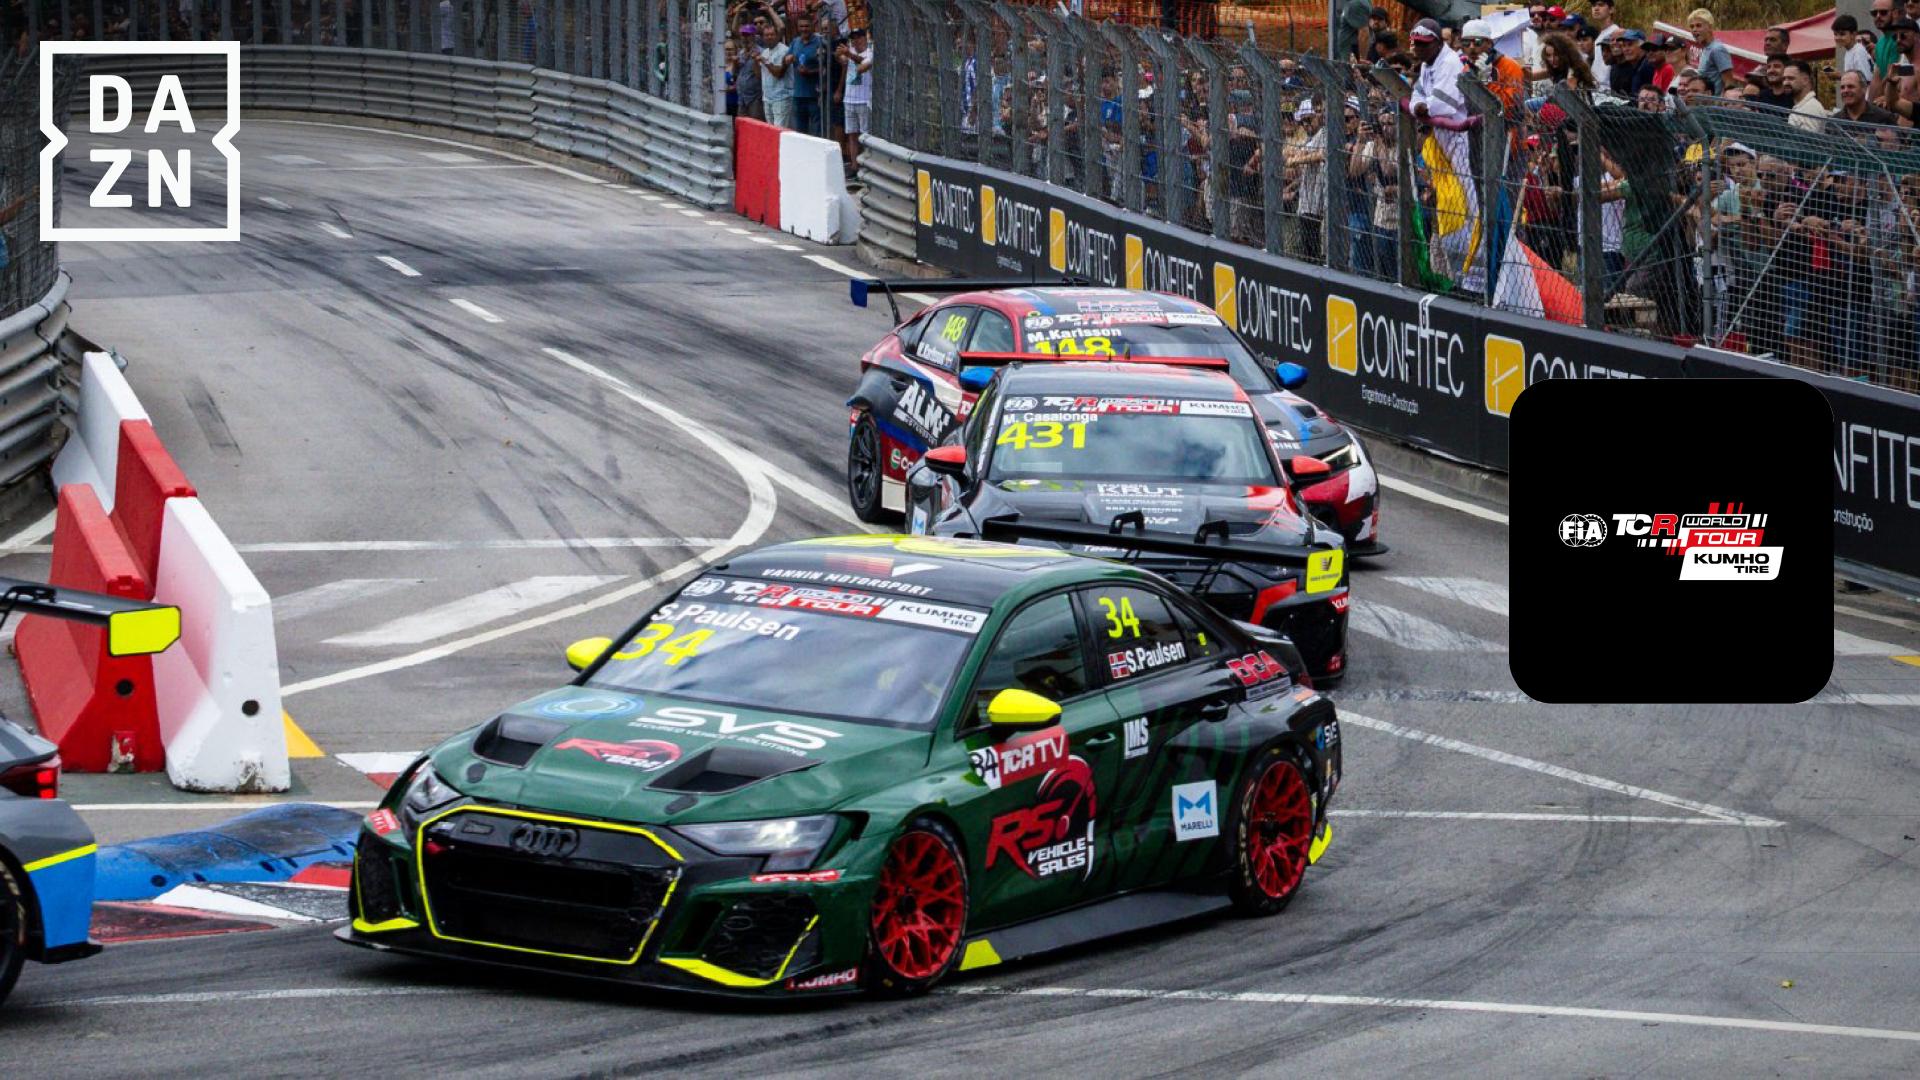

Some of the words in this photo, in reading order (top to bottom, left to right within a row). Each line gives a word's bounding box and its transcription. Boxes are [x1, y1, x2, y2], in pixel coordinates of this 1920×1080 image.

[932, 178, 975, 234] CONFITEC
[997, 196, 1042, 258] CONFITEC
[1067, 220, 1117, 286] CONFITEC
[941, 314, 967, 342] 148
[1238, 276, 1312, 353] CONFITEC
[1034, 336, 1117, 356] 148
[1360, 311, 1464, 398] CONFITEC
[996, 421, 1087, 449] 431
[761, 568, 817, 581] VANNIN
[825, 572, 934, 596] MOTORSPORT
[651, 601, 801, 641] S.Paulsen
[798, 597, 875, 616] TOUR
[899, 603, 977, 623] KUMHO
[1099, 596, 1141, 638] 34
[612, 623, 717, 666] 34
[1125, 641, 1186, 673] S.Paulsen
[636, 706, 844, 750] SVS
[970, 749, 999, 779] 34
[1001, 744, 1035, 775] TCR
[1035, 734, 1066, 763] TV
[1027, 837, 1087, 865] VEHICLE
[1038, 852, 1086, 876] SALES
